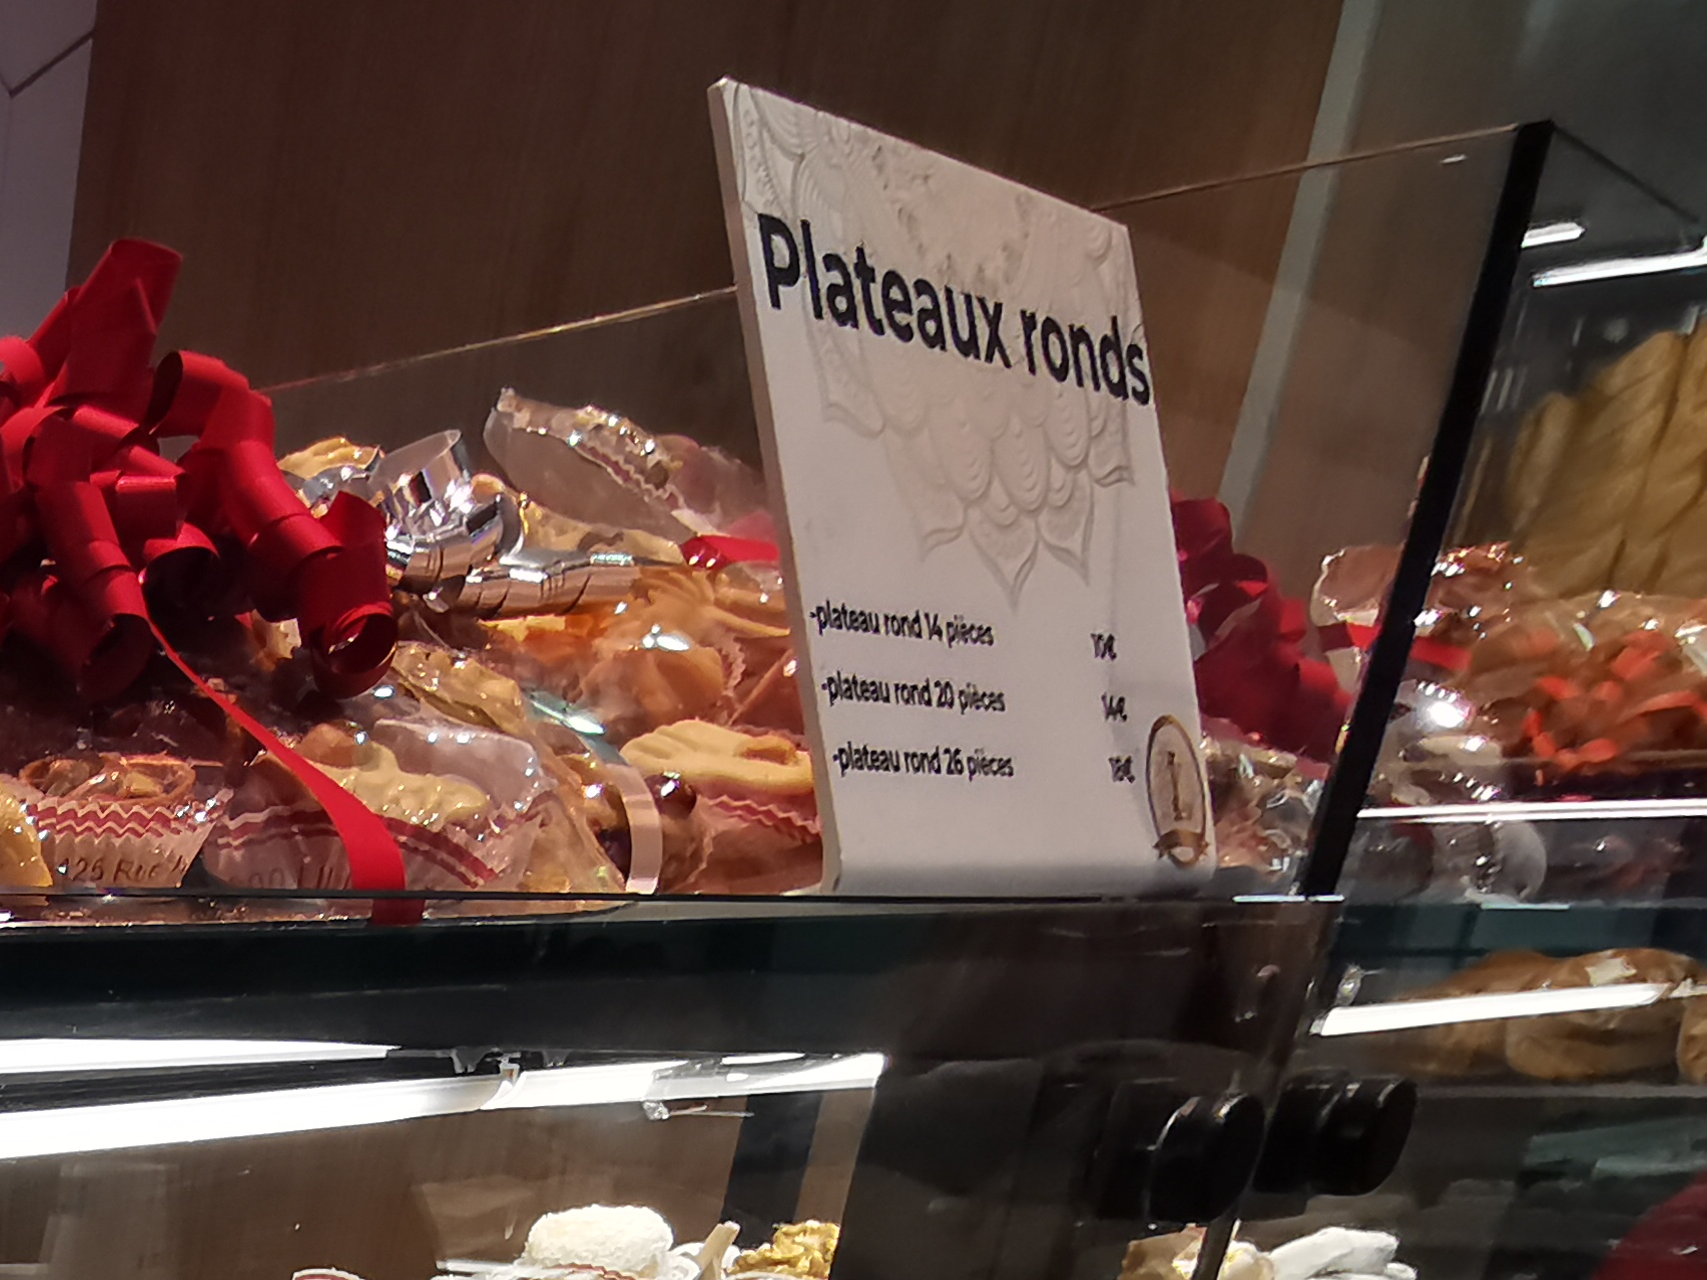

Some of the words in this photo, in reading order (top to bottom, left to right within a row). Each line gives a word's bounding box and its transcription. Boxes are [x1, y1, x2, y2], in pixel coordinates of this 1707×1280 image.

[757, 212, 1013, 369] Plateaux
[1020, 309, 1150, 405] ronds
[883, 609, 923, 639] rond
[924, 612, 943, 641] 14
[893, 677, 933, 707] rond
[934, 680, 955, 709] 20
[903, 745, 942, 774] rond
[943, 748, 964, 775] 26
